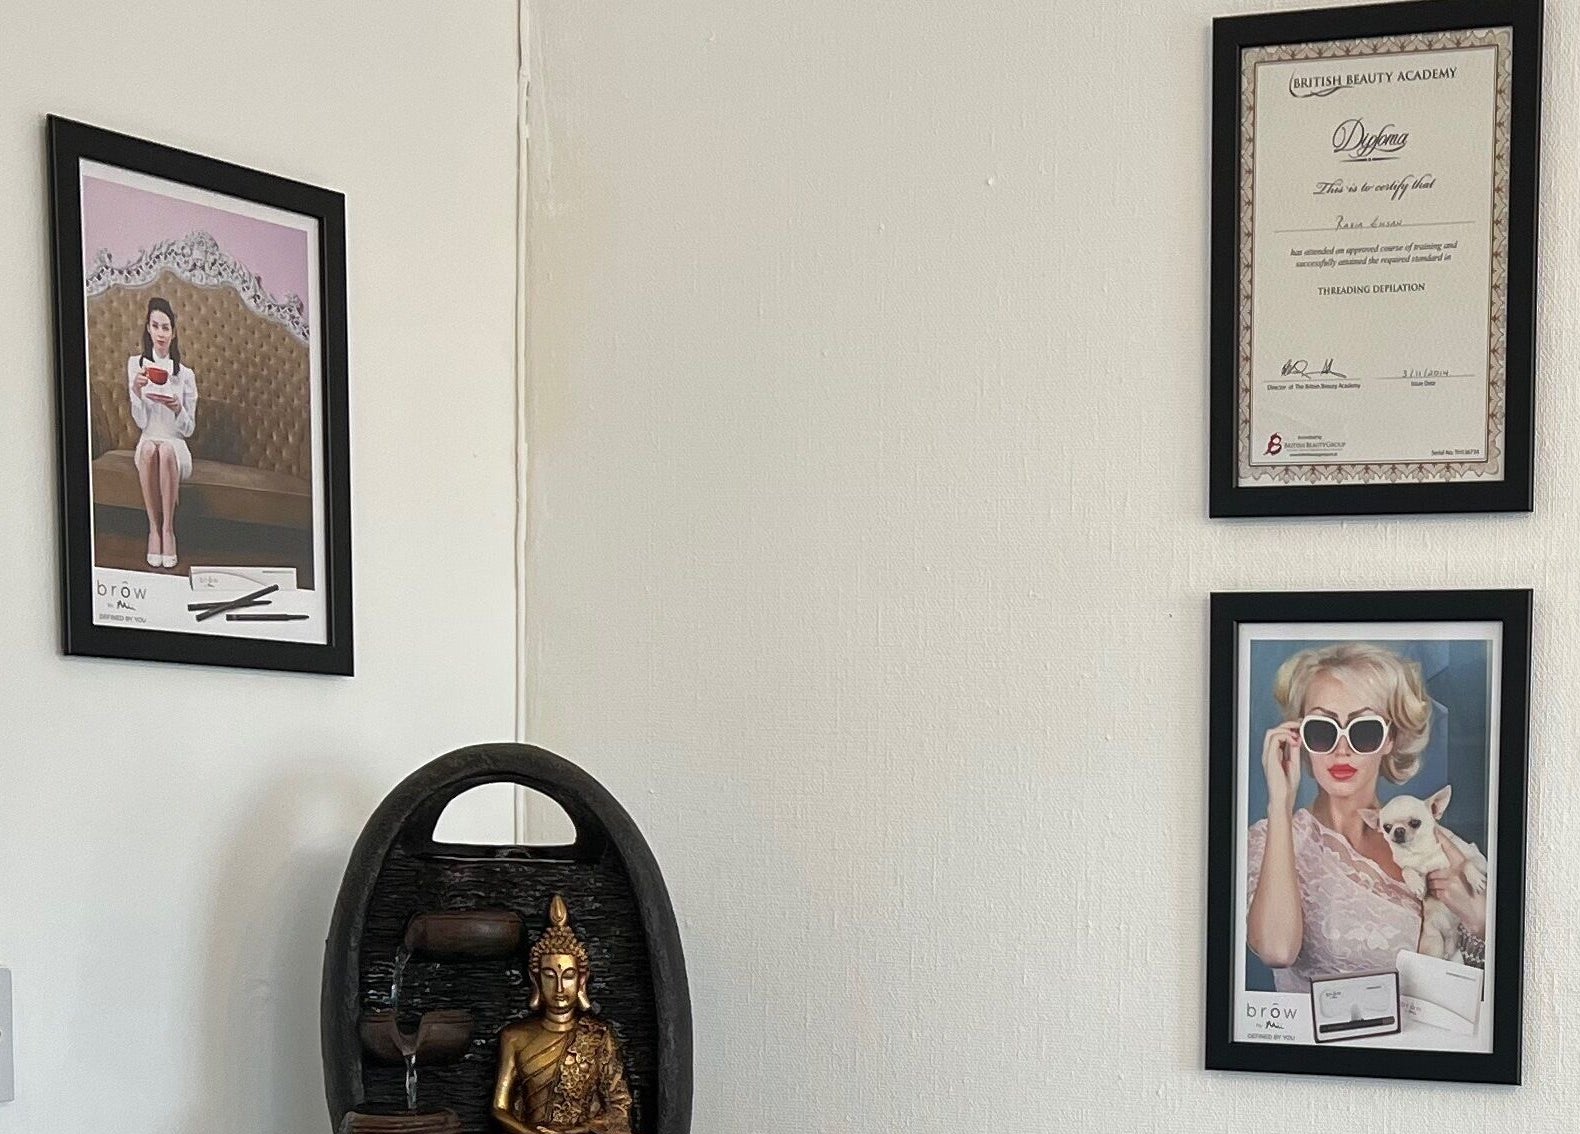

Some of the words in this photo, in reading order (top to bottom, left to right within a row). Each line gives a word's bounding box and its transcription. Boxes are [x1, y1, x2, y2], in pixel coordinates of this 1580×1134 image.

[1292, 75, 1341, 90] BRITISH
[1346, 71, 1394, 86] BEAUTY
[1397, 66, 1458, 82] ACADEMY
[1332, 117, 1409, 159] Diploma
[1313, 178, 1343, 195] This
[1347, 183, 1357, 192] is
[1361, 182, 1371, 192] to
[1375, 174, 1414, 201] certify
[1412, 174, 1436, 189] that
[1318, 286, 1370, 295] THREADING
[1373, 283, 1425, 293] DEPILATION
